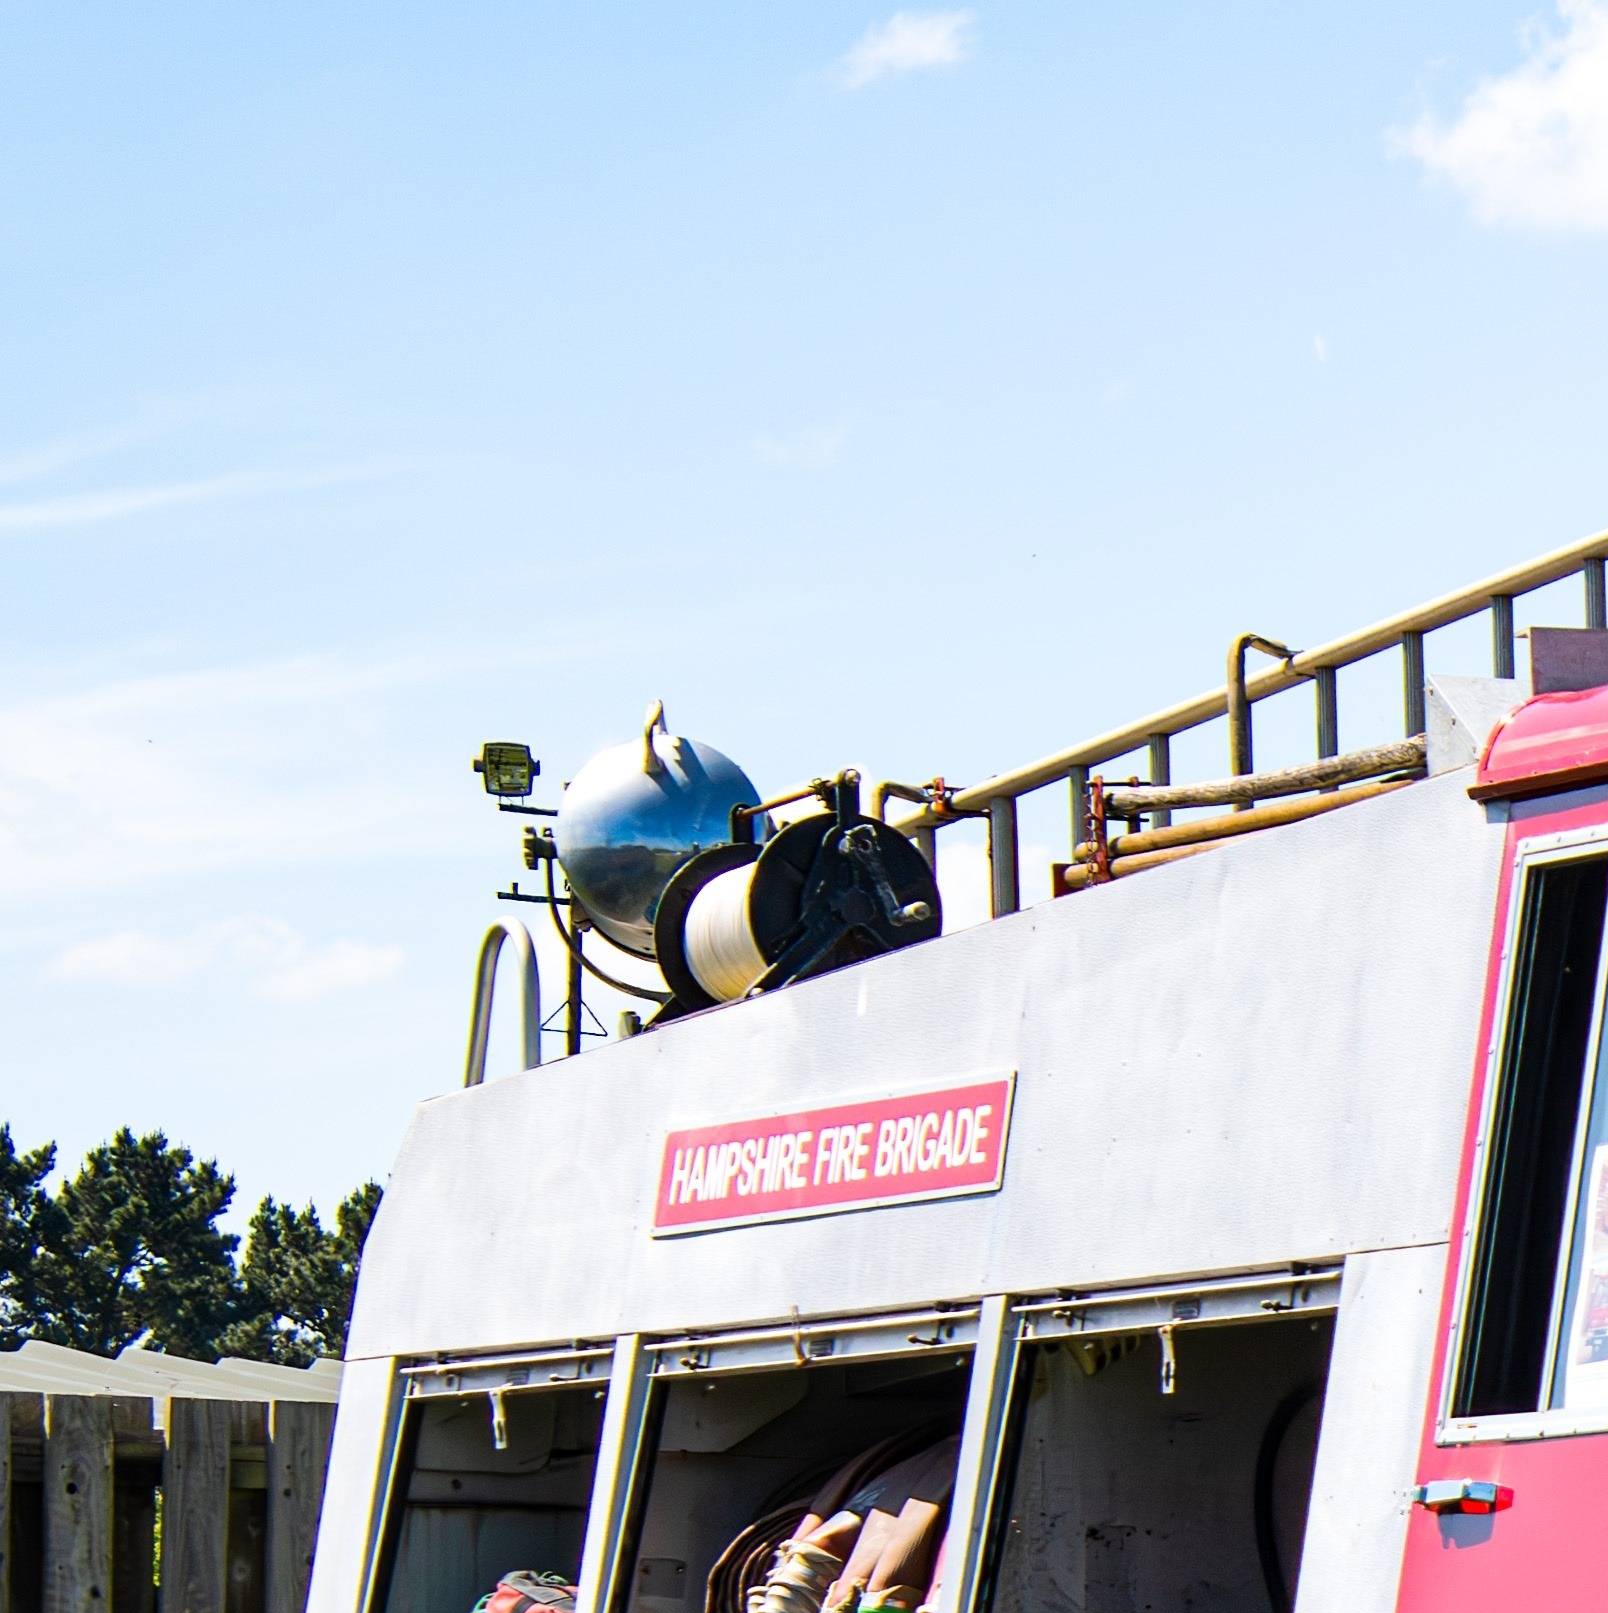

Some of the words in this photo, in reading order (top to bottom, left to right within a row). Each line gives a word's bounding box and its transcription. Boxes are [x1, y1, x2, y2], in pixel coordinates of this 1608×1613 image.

[668, 1131, 812, 1205] HAMPSHIRE
[814, 1122, 872, 1186] FIRE
[874, 1104, 992, 1178] BRIGADE
